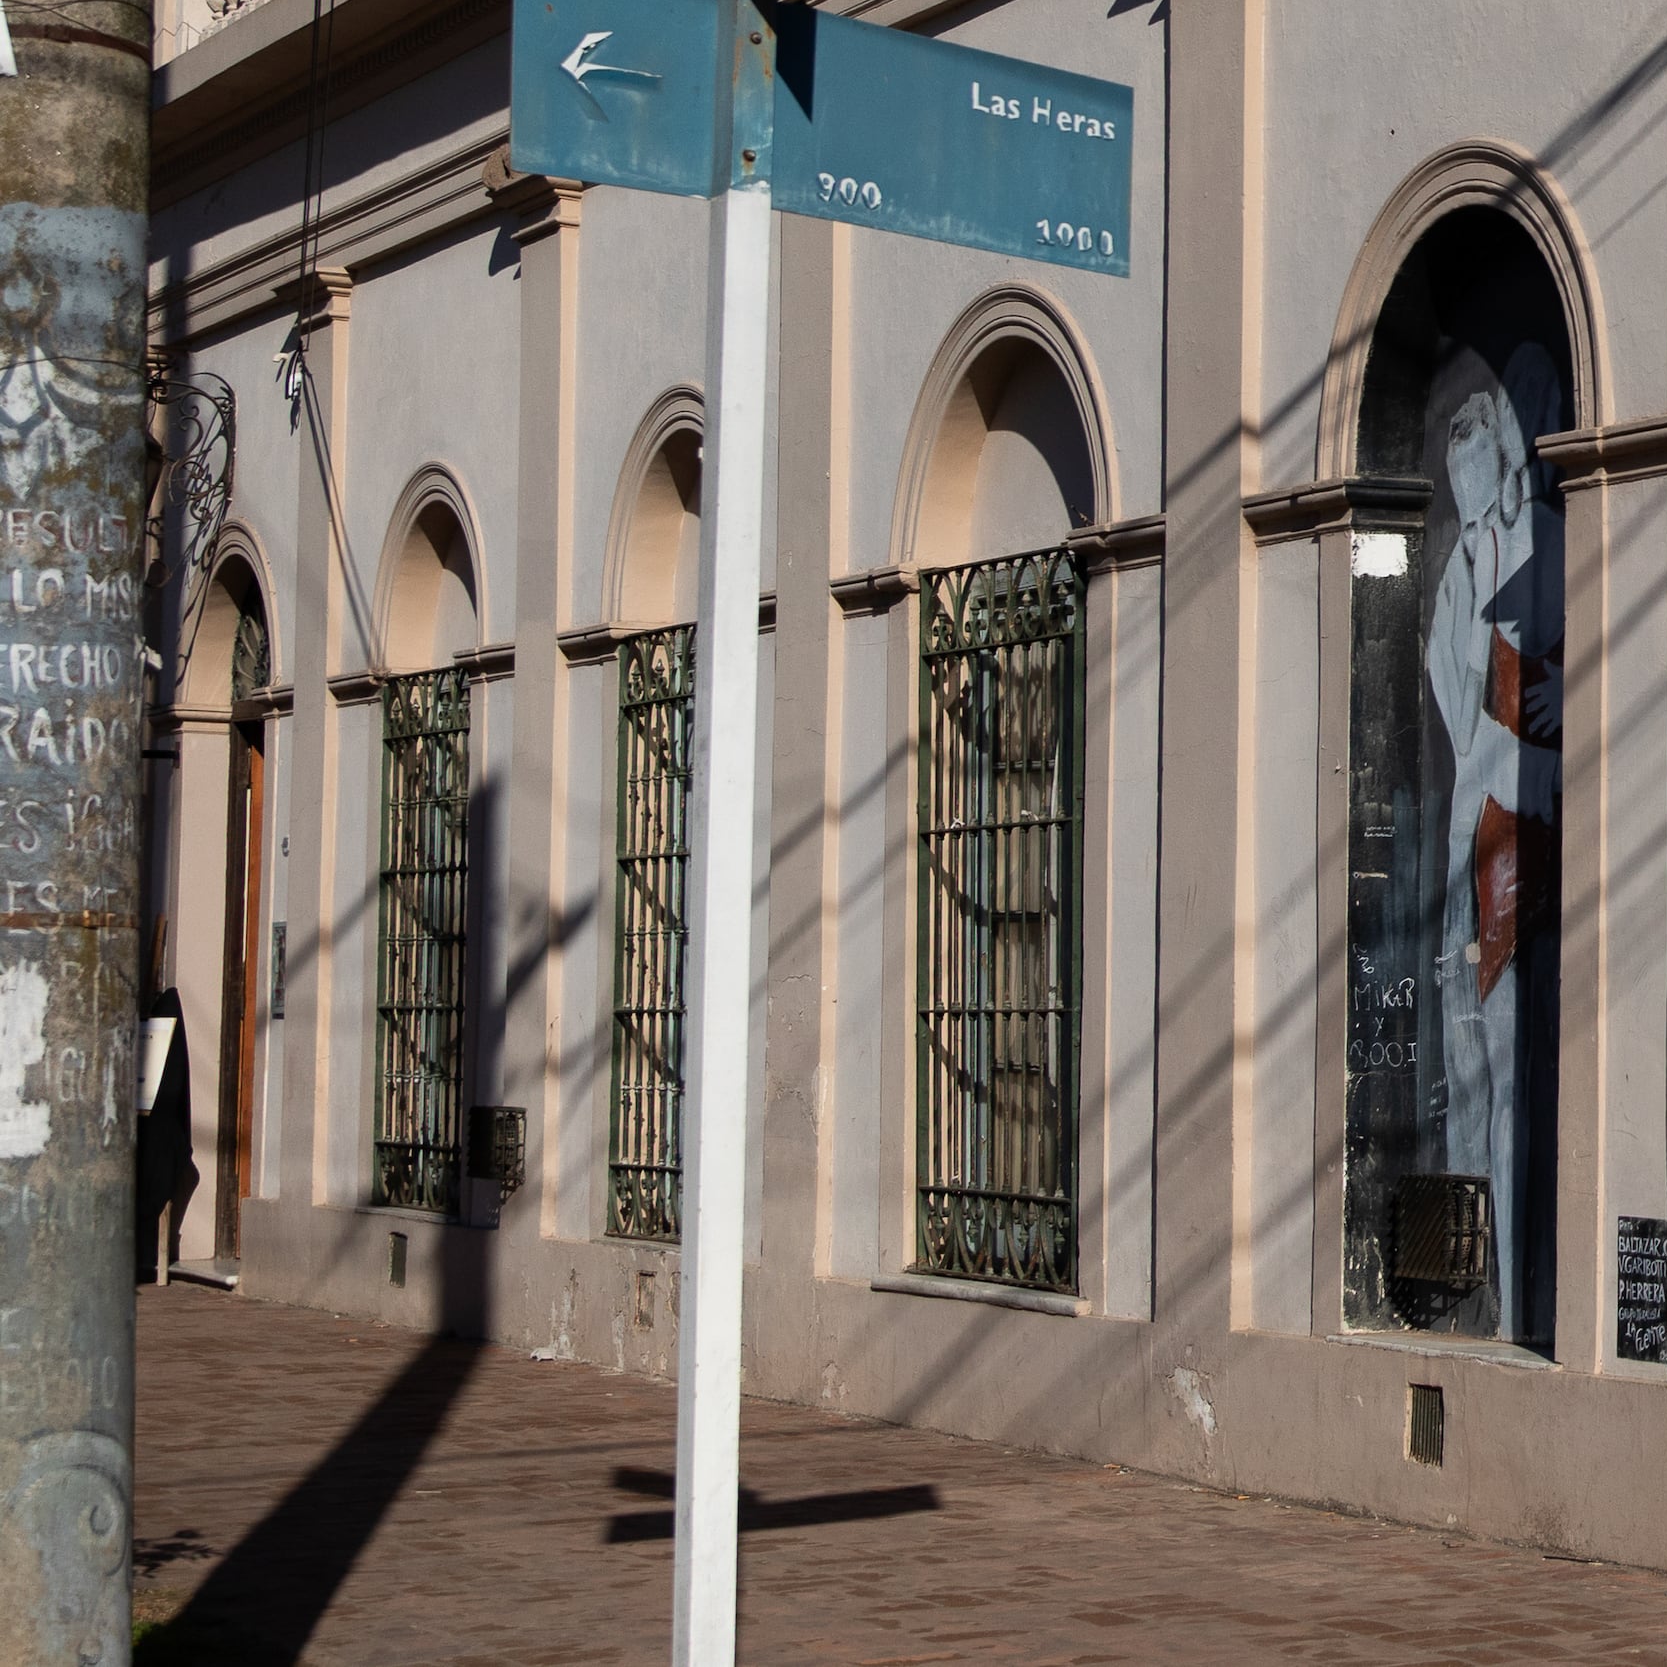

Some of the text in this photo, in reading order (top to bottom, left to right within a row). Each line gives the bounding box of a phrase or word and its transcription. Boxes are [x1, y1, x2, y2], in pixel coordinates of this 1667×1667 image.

[971, 81, 1116, 140] Las Heras
[817, 172, 882, 210] 900
[1035, 218, 1114, 256] 1000
[12, 568, 66, 614] LO
